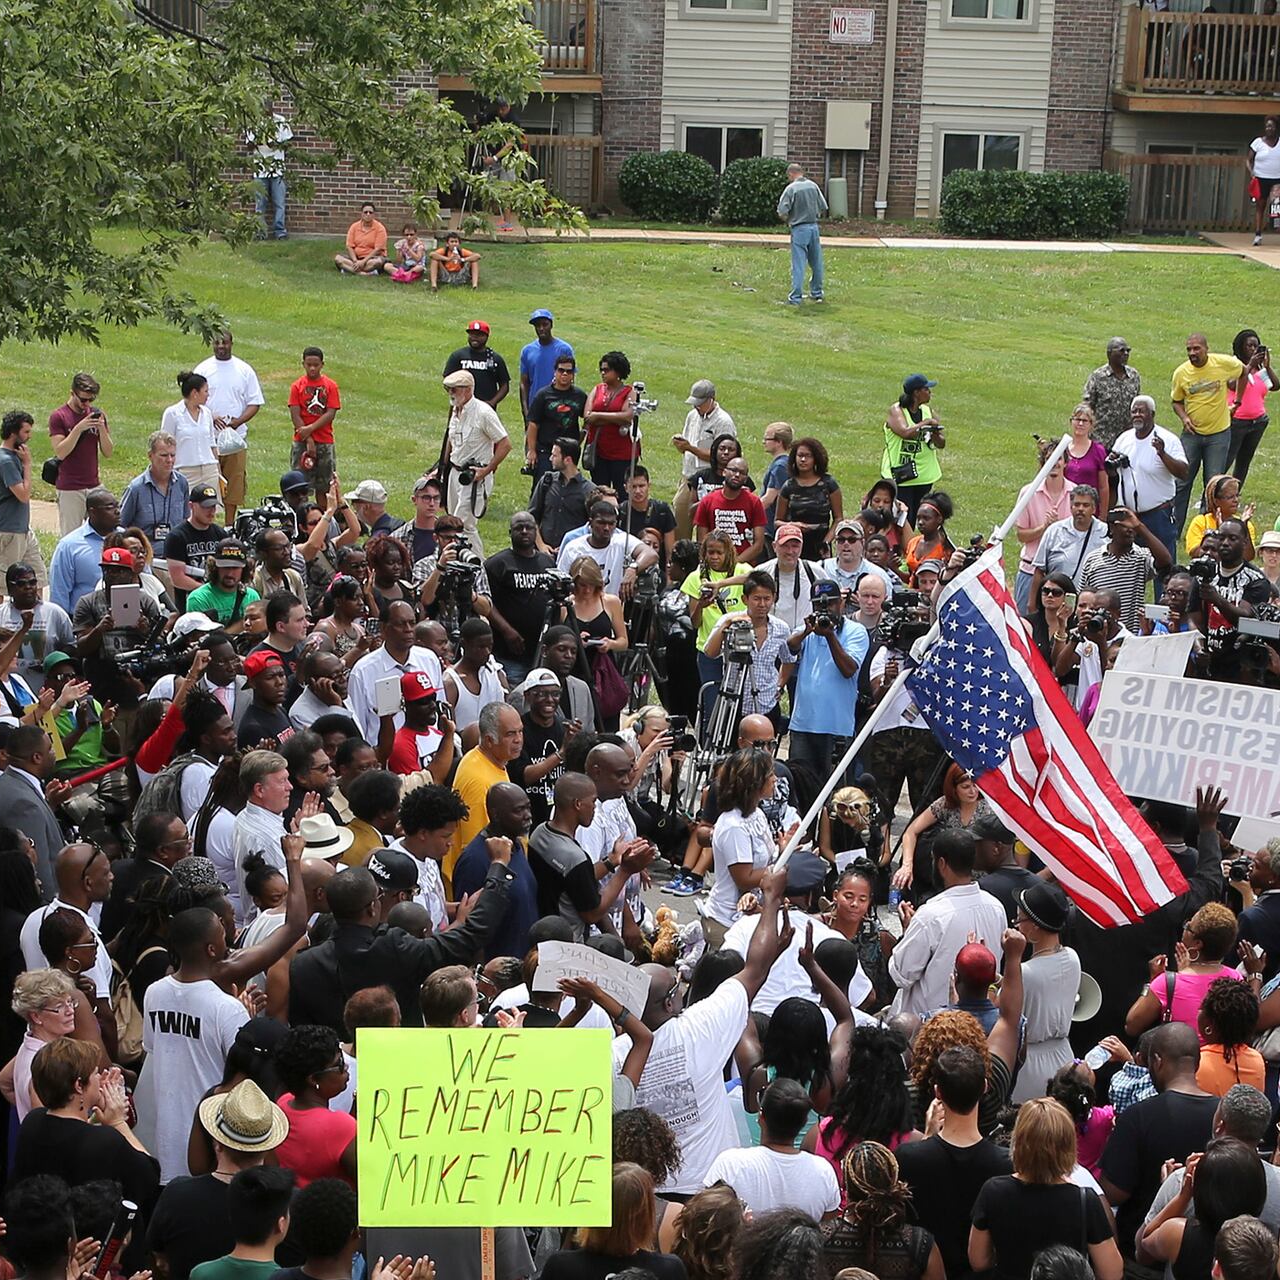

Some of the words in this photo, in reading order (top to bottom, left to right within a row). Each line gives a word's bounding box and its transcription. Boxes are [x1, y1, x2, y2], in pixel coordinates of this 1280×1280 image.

[833, 17, 847, 34] NO
[148, 1010, 201, 1040] TWIN
[447, 1033, 521, 1086] WE
[370, 1086, 605, 1150] REMEMBER
[380, 1152, 491, 1211] MIKE
[497, 1147, 606, 1208] MIKE
